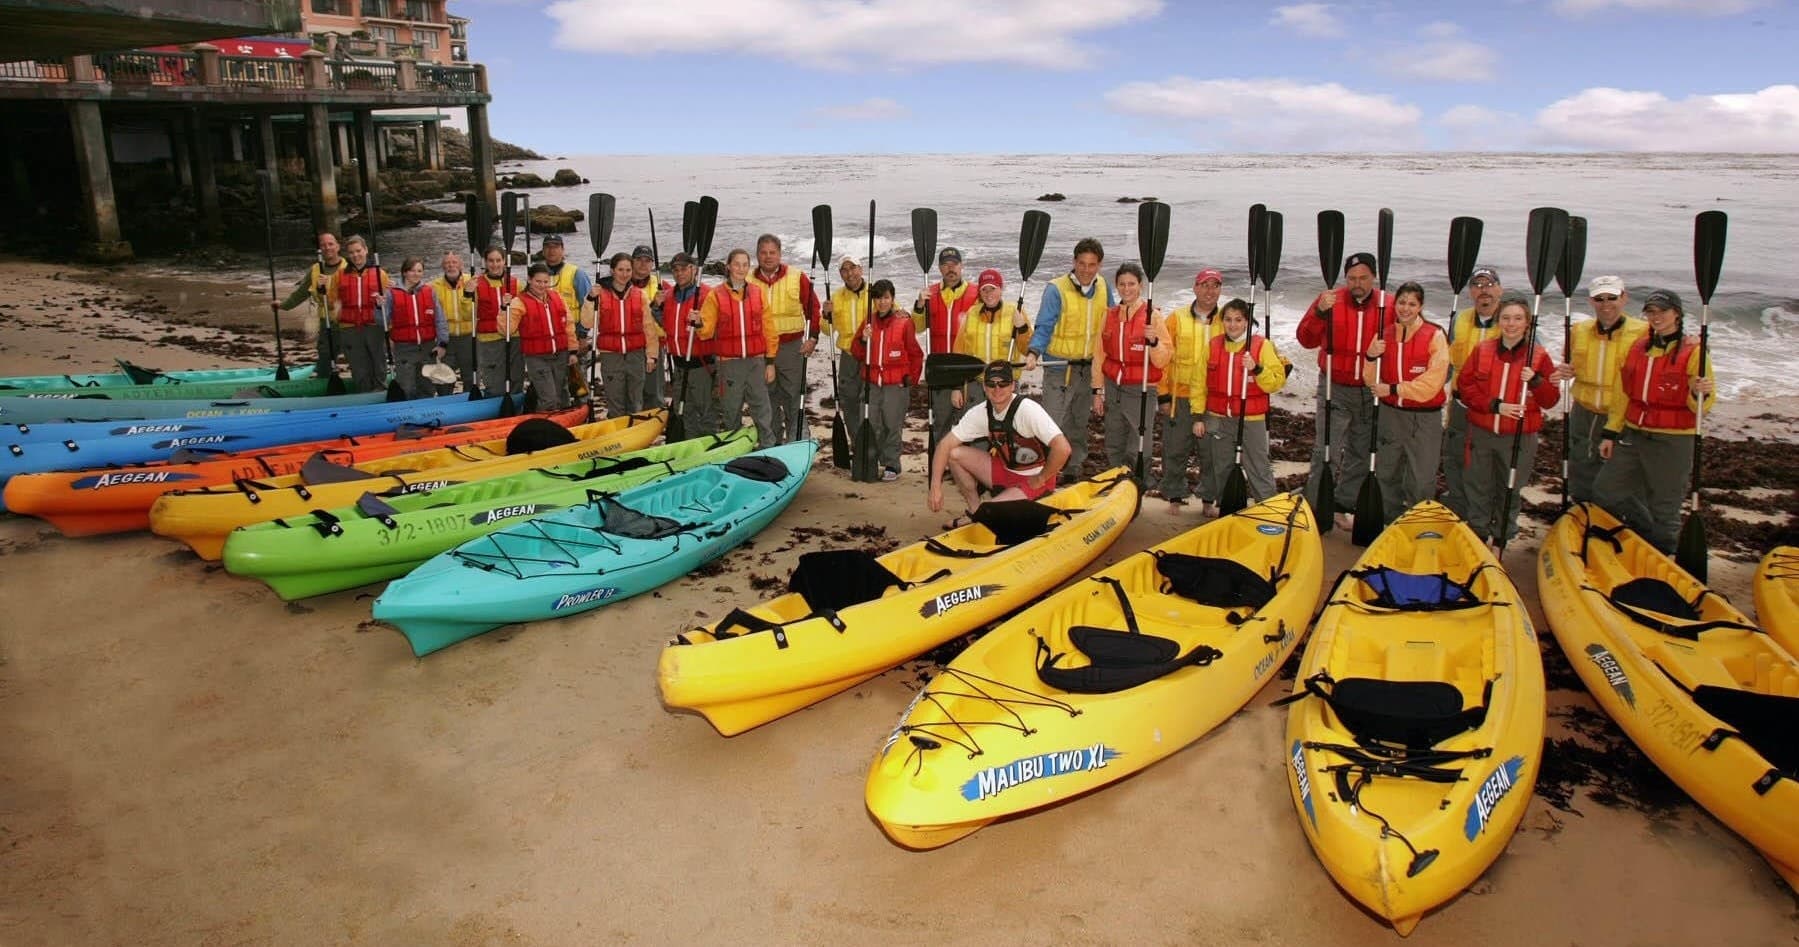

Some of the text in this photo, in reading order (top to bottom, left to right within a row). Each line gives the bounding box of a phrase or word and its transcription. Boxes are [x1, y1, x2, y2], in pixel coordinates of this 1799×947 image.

[186, 408, 271, 419] OCEAN KAYAK
[127, 424, 182, 436] AEGEAN
[169, 435, 225, 448] AEGEAN
[95, 471, 169, 489] AEGEAN
[487, 504, 535, 524] AEGEAN
[556, 588, 605, 610] PROWLER
[936, 584, 982, 615] AEGEAN
[1592, 650, 1628, 686] AEGEAN
[978, 743, 1108, 801] MALIBU TWO XL
[1475, 762, 1512, 833] AEGEAN
